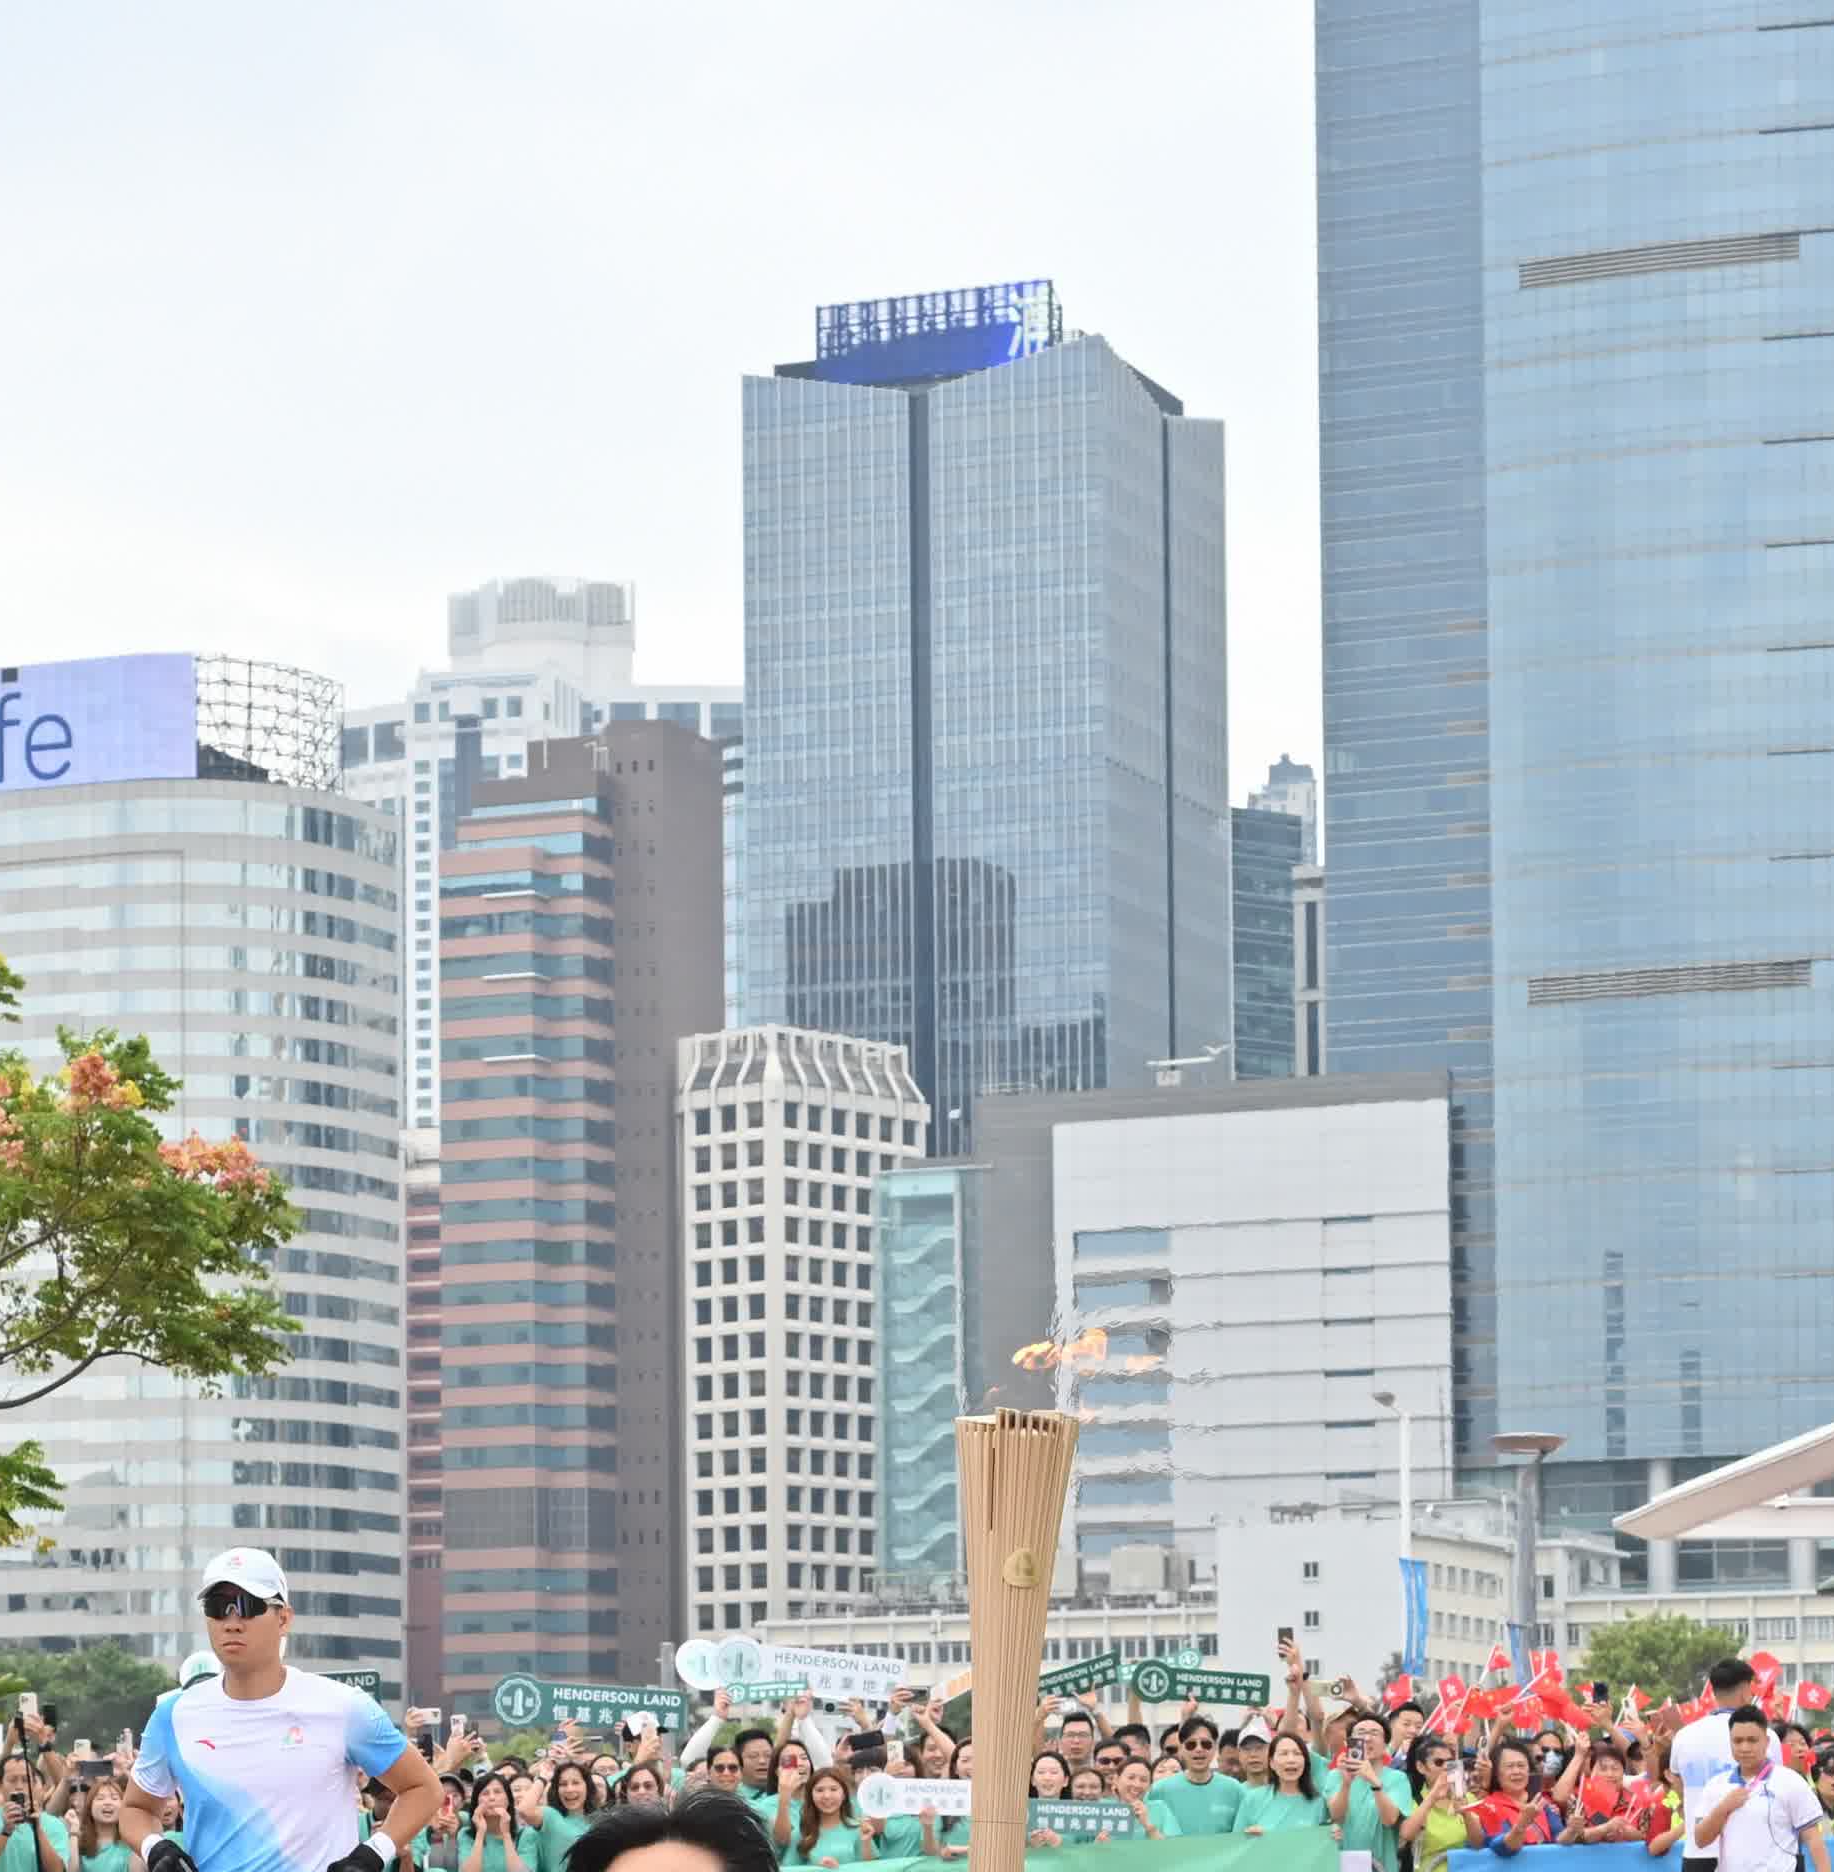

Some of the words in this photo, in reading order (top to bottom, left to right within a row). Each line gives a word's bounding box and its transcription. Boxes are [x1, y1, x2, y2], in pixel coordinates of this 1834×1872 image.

[774, 1652, 859, 1672] HENDERSON
[863, 1661, 901, 1675] LAND
[1039, 1666, 1090, 1689] ENDERSON
[1175, 1672, 1236, 1686] HENDERSON
[1236, 1677, 1264, 1689] LAND
[553, 1687, 640, 1705] HENDERSON
[643, 1693, 682, 1708] LAND
[1037, 1803, 1100, 1816] HENDERSON
[1101, 1806, 1131, 1817] LAND
